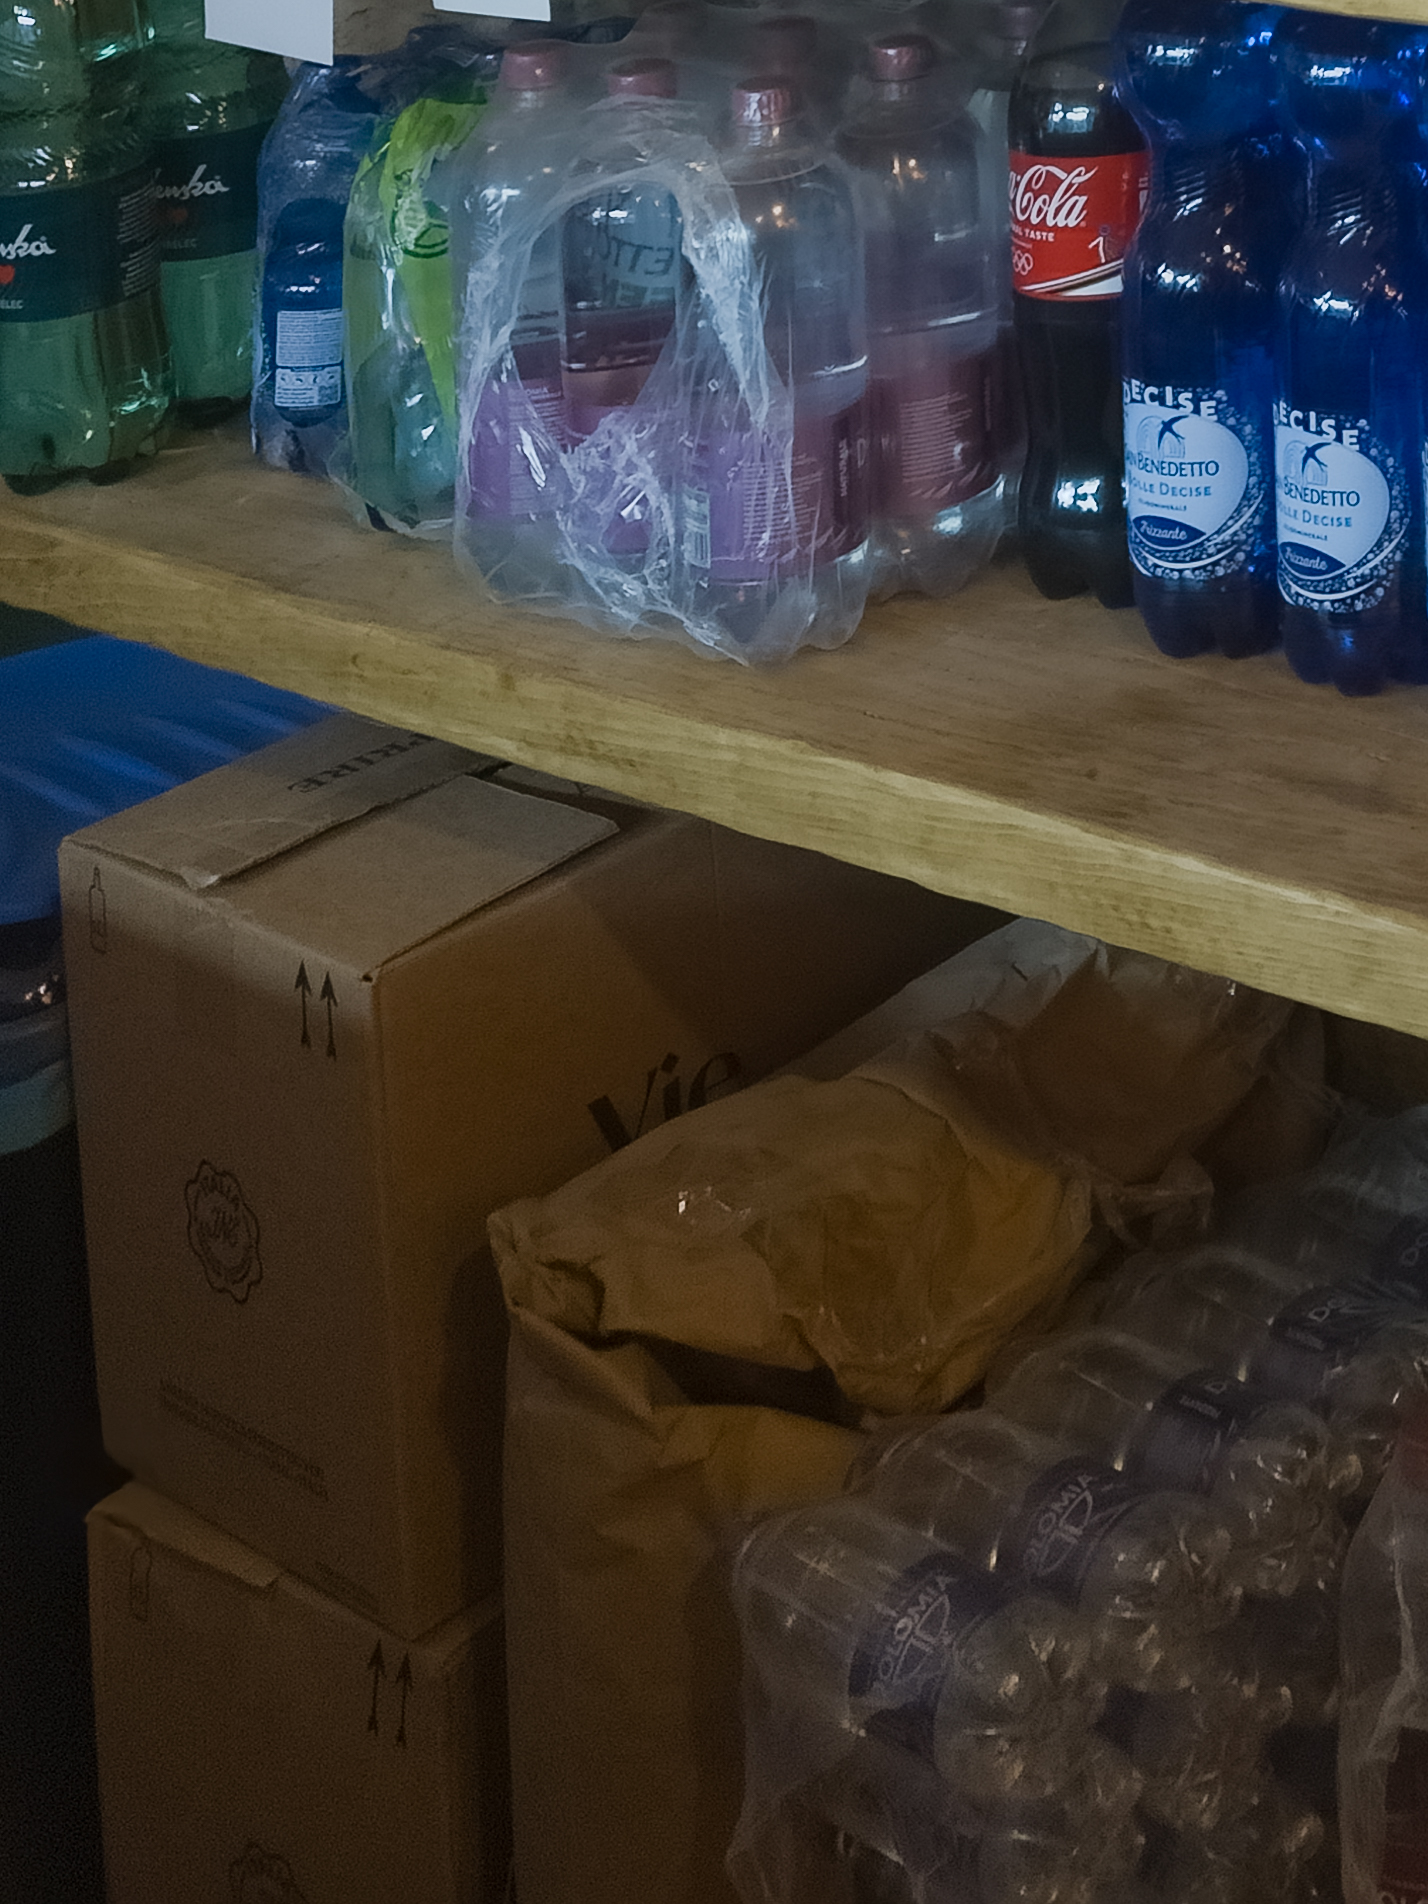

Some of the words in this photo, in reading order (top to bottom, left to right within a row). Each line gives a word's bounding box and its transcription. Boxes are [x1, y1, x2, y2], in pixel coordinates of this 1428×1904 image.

[1023, 229, 1055, 243] TASTE
[1138, 453, 1221, 479] BENEDETTO
[1159, 480, 1213, 498] DECISE
[1282, 475, 1361, 509] BENEDETTO
